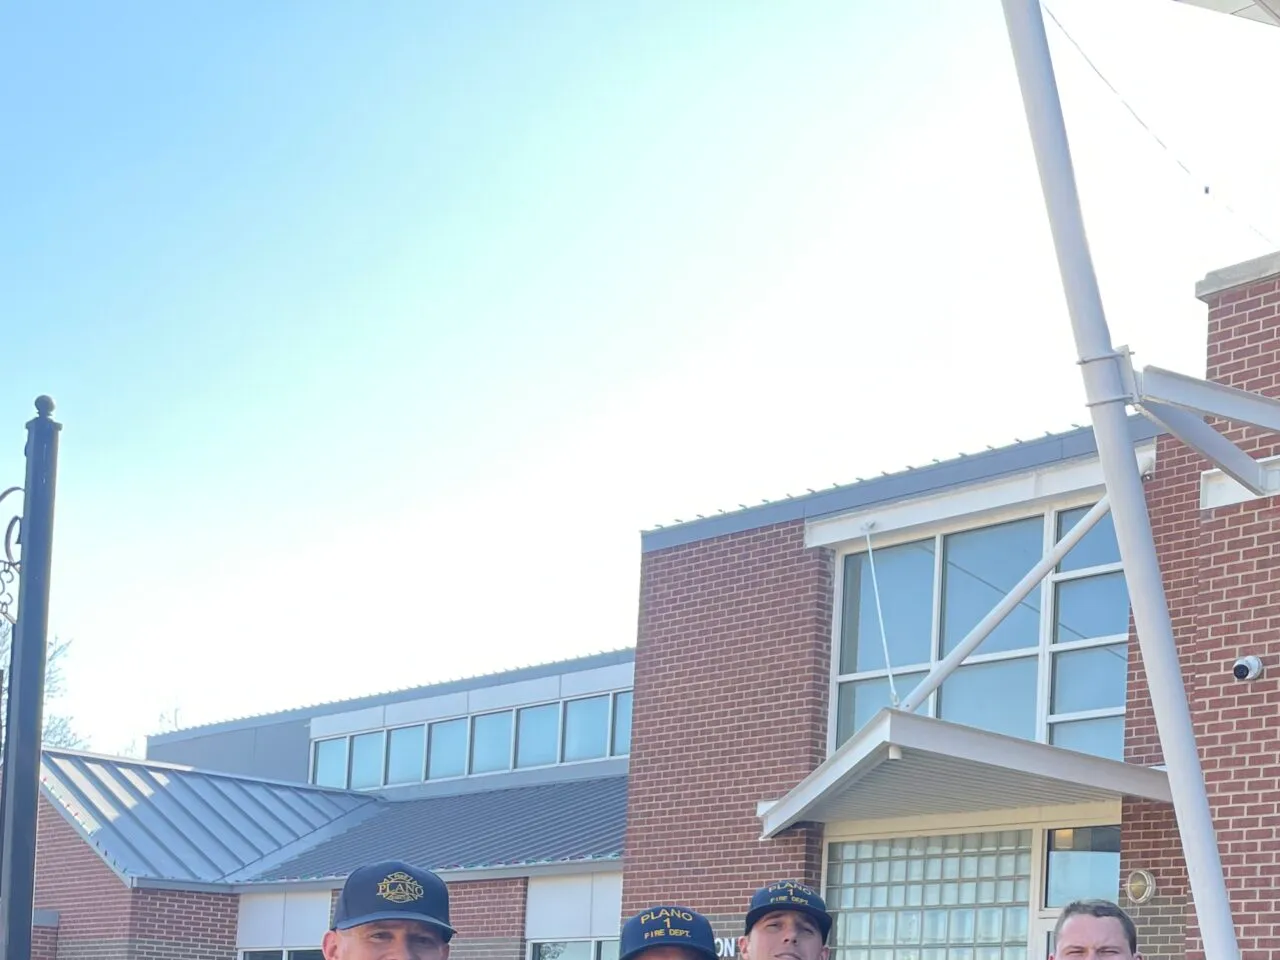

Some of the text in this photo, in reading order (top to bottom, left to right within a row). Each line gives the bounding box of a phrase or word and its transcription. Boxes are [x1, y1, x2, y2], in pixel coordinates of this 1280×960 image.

[376, 882, 425, 898] PLANO
[768, 881, 812, 896] PLANO
[641, 908, 693, 925] PLANO
[663, 917, 671, 928] 1
[644, 928, 692, 940] FIRE DEPT.
